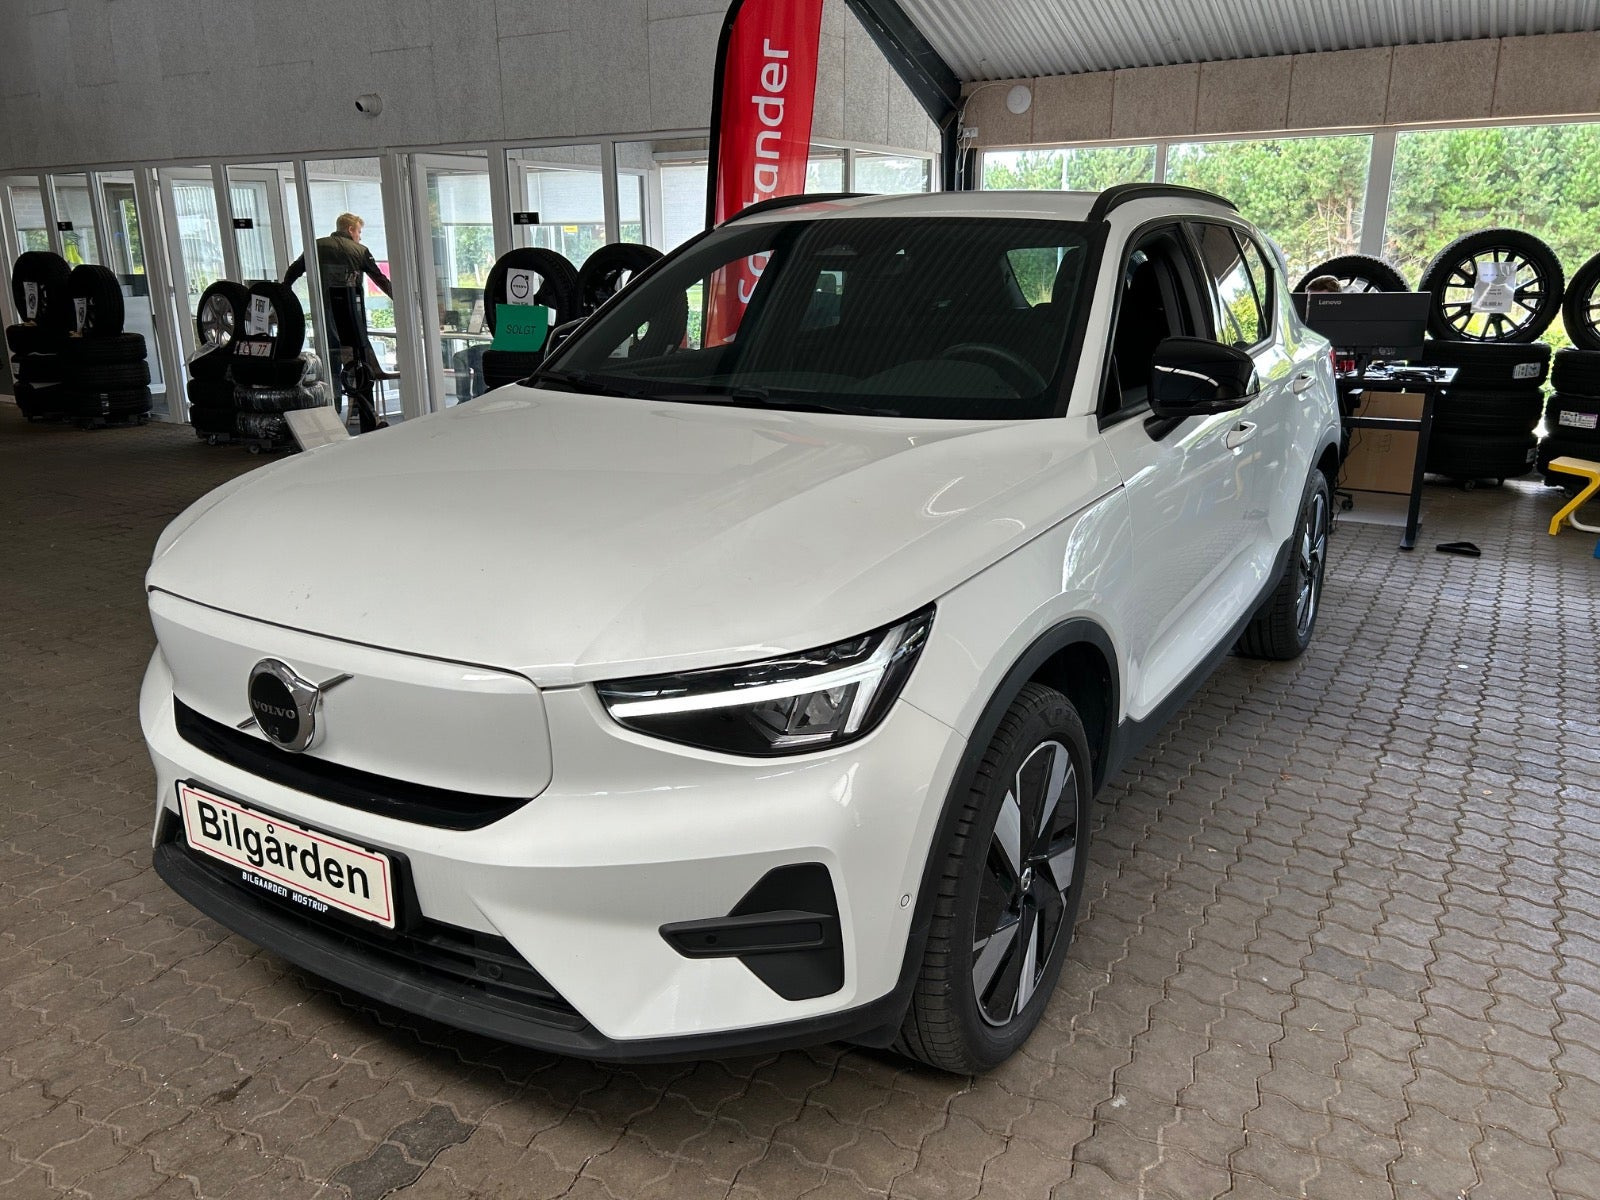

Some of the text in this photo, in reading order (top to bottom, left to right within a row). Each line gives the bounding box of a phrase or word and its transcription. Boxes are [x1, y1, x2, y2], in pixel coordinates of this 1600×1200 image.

[736, 38, 790, 304] Saander
[506, 324, 536, 335] SOLGT
[252, 698, 296, 720] VOLVO
[197, 800, 370, 900] Bilgården
[242, 871, 329, 913] BILGAARDEN HOSTRUP
